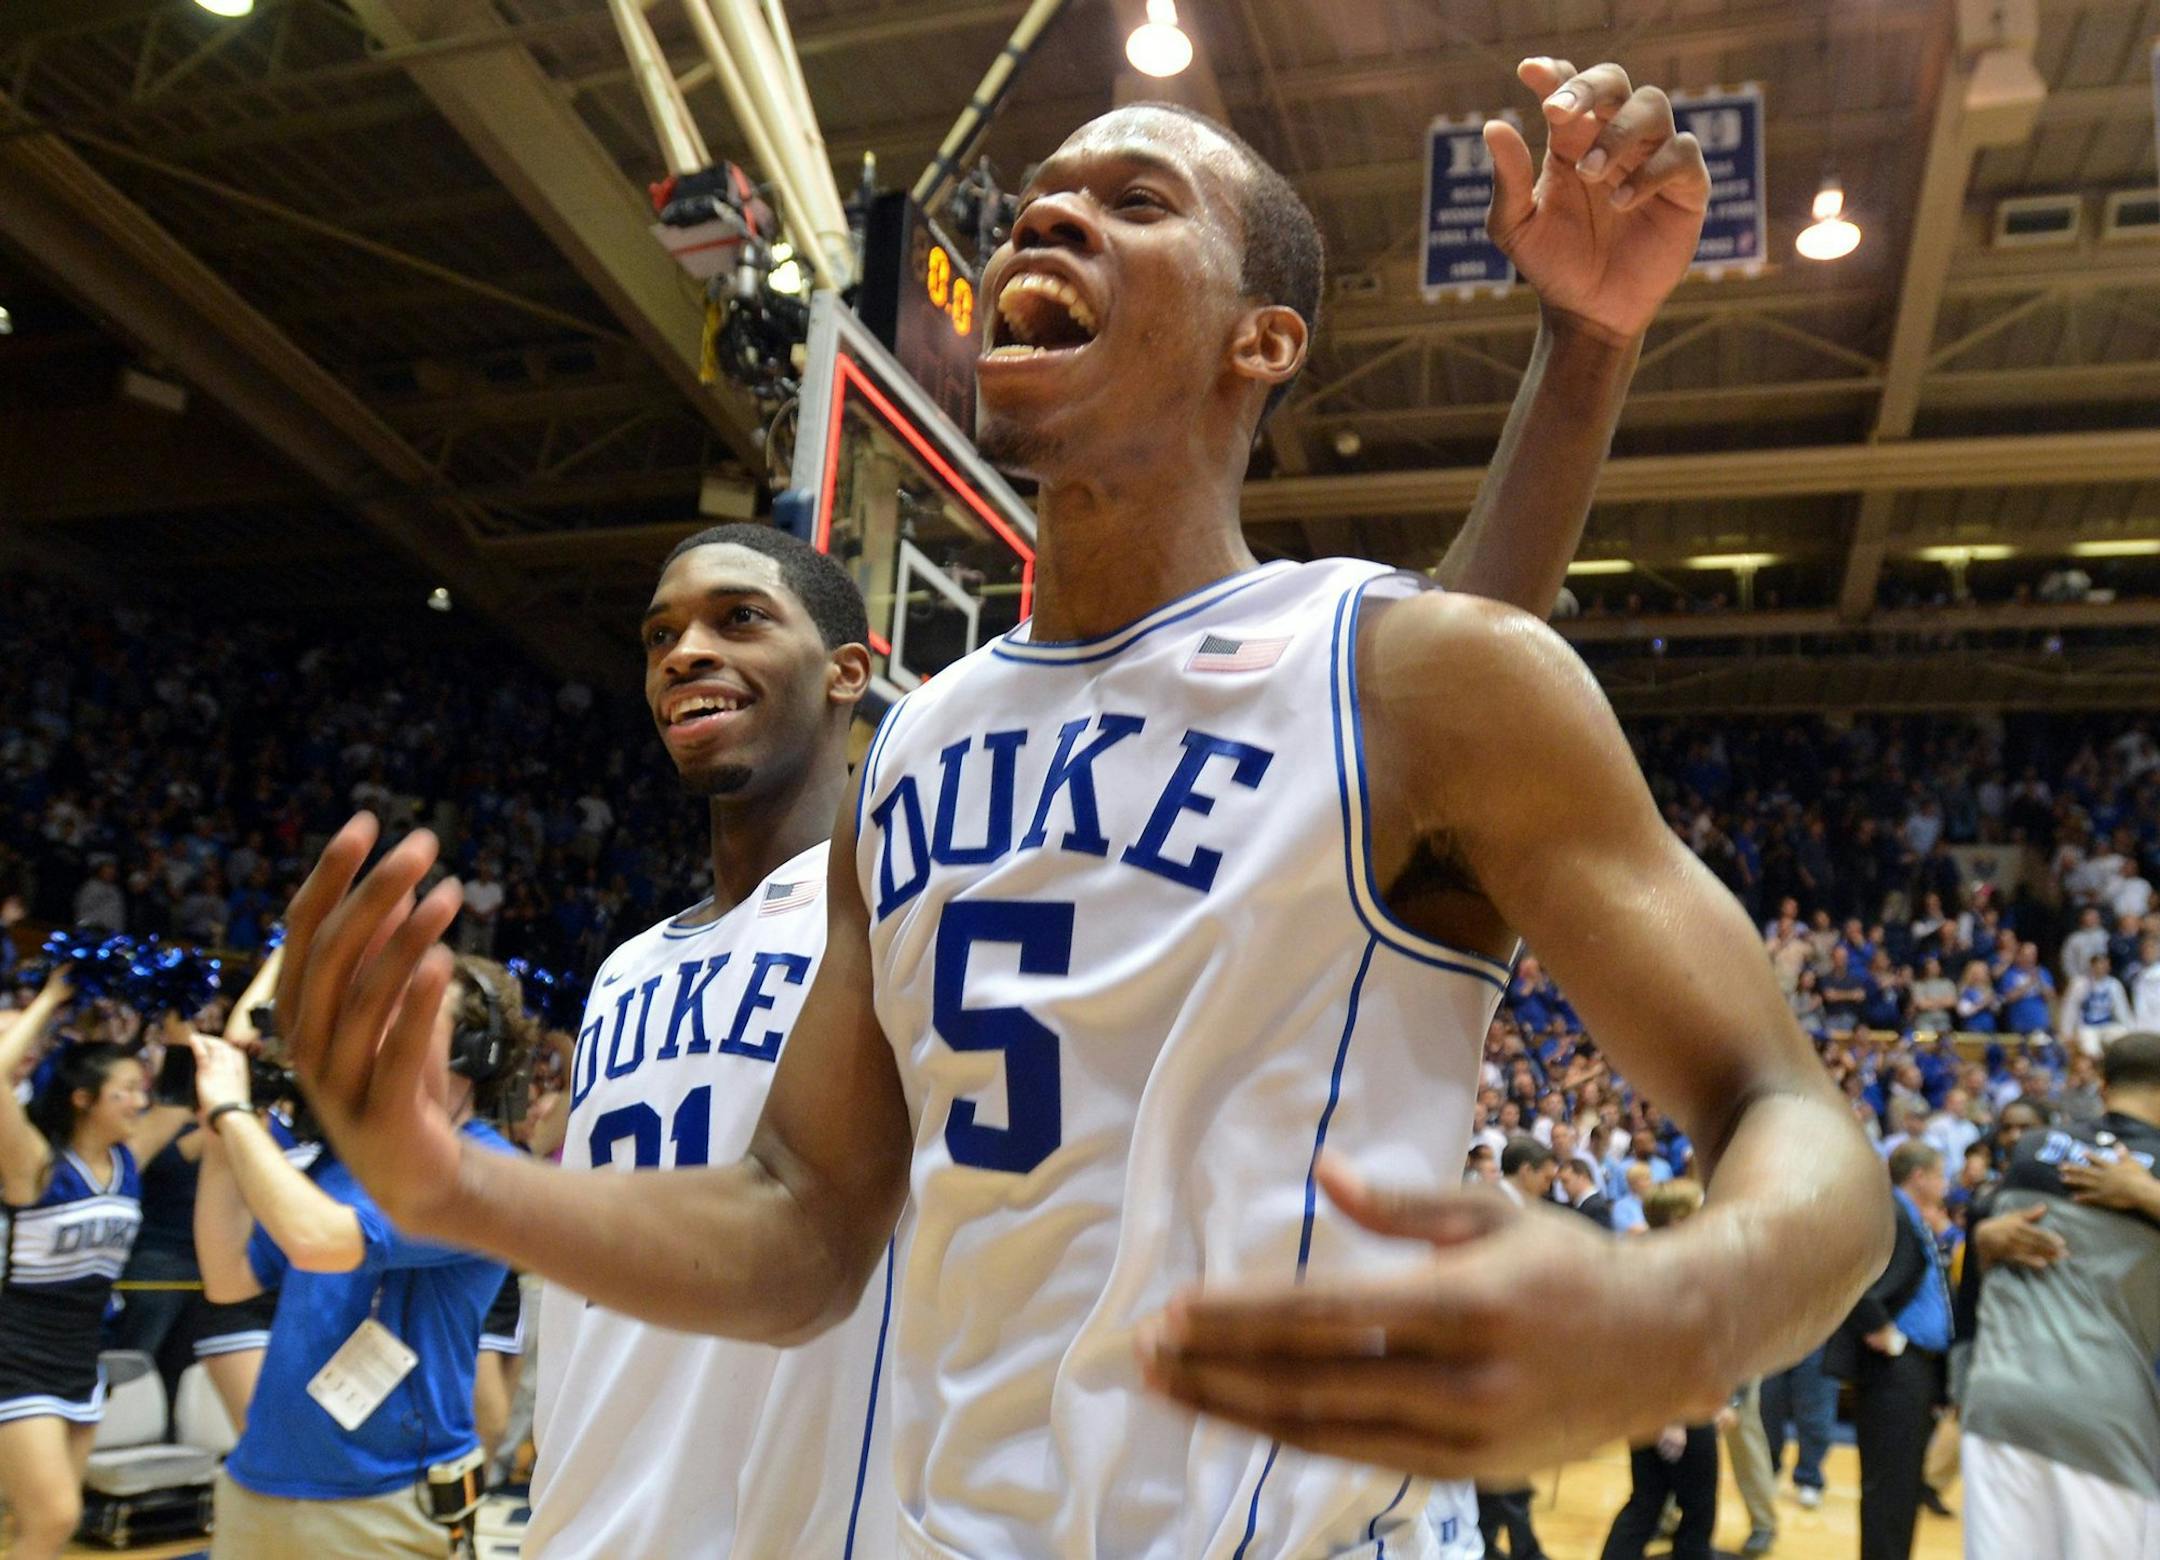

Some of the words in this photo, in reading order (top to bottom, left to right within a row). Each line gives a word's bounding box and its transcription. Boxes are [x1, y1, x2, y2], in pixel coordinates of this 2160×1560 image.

[871, 713, 1274, 922] DUKE
[571, 951, 812, 1112] DUKE
[933, 901, 1075, 1174] 5
